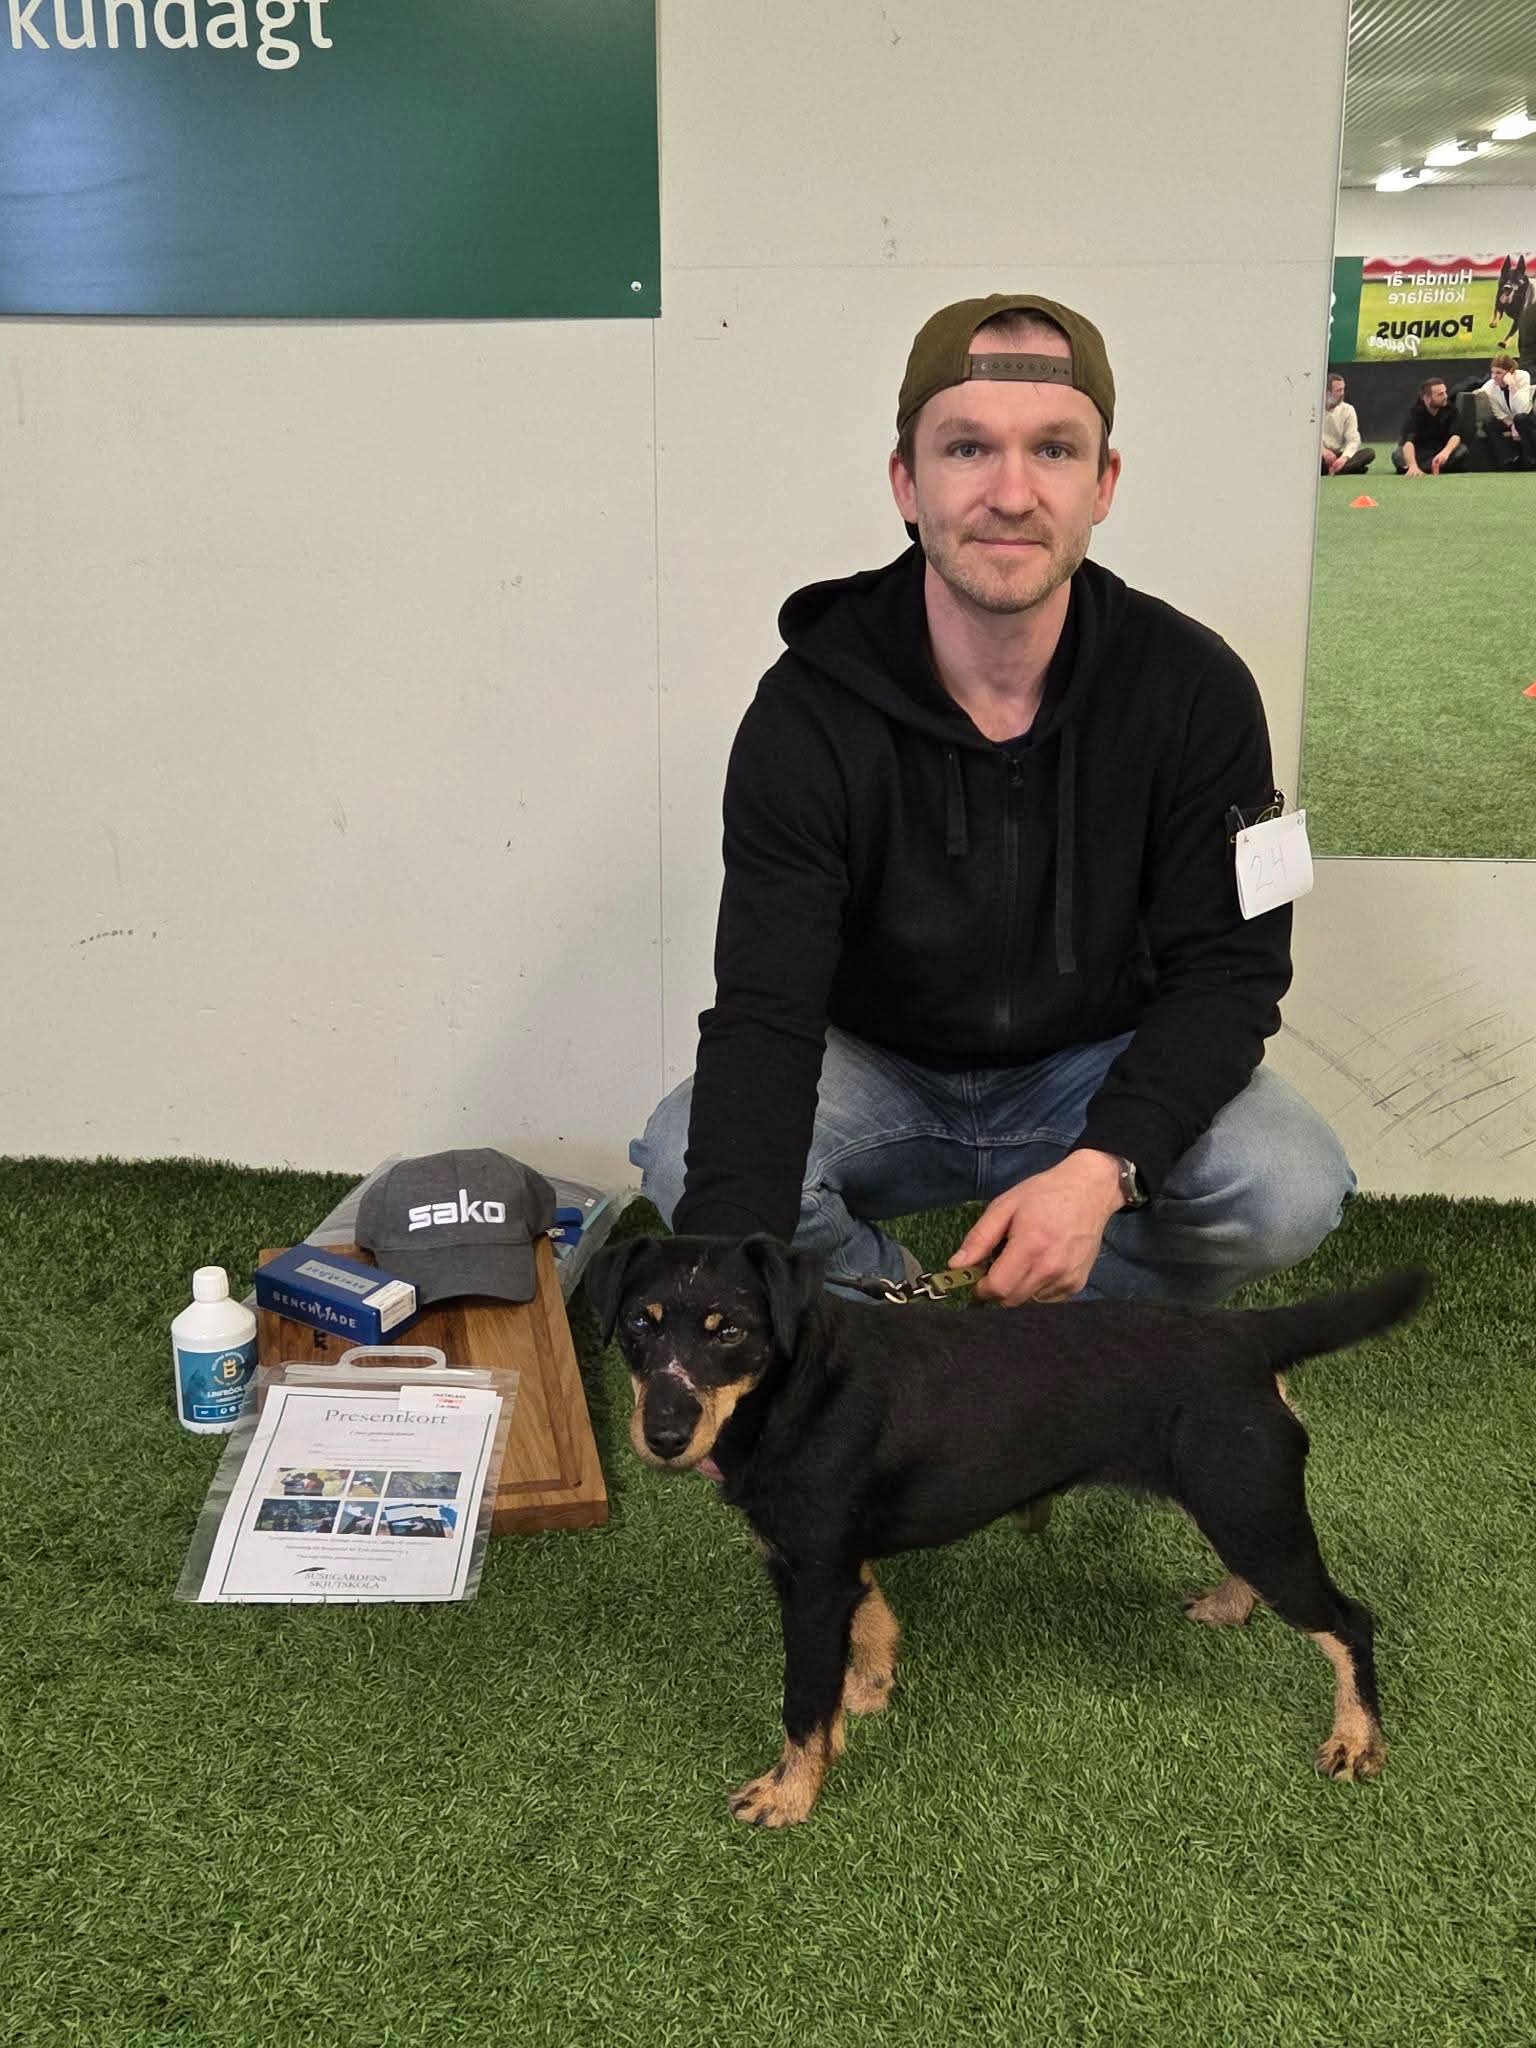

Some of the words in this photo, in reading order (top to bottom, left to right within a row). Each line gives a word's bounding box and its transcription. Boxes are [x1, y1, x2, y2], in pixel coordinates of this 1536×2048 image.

[408, 1189, 506, 1232] sako
[272, 1291, 358, 1329] BENCHMADE
[325, 1409, 448, 1424] Presentkort
